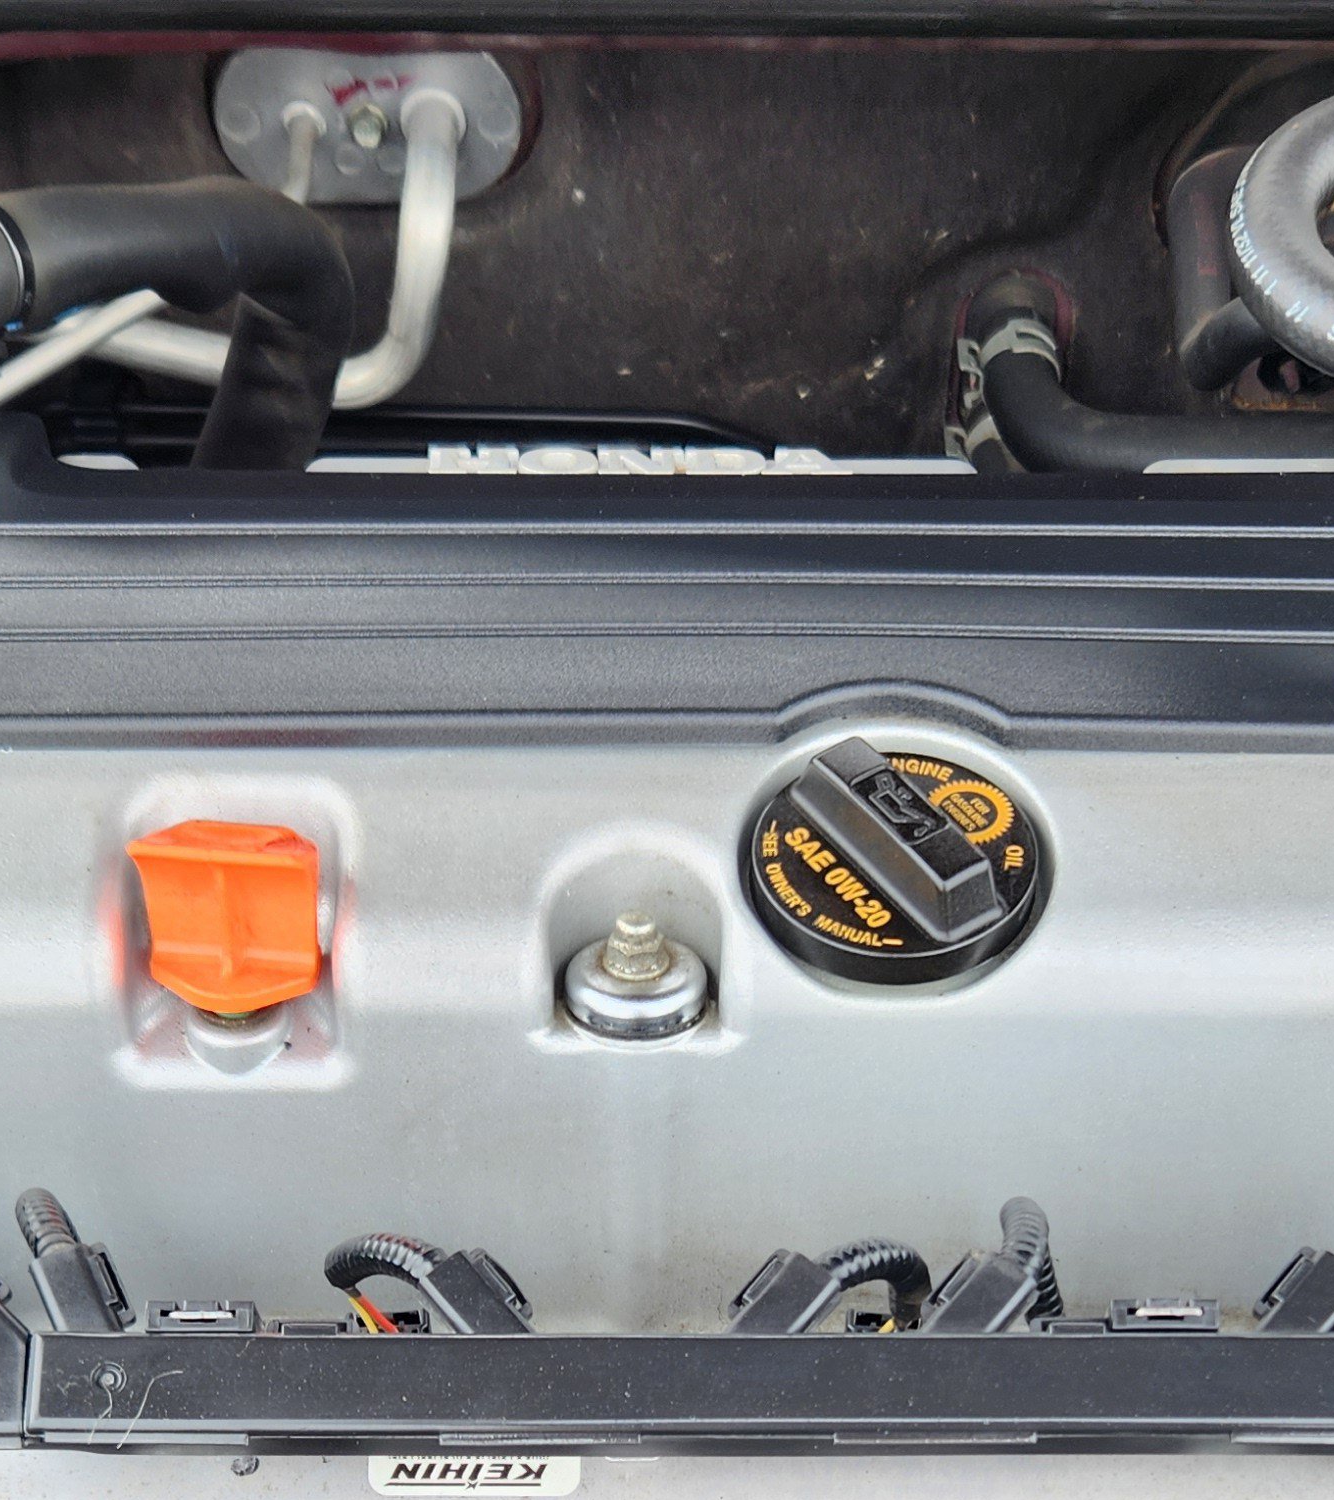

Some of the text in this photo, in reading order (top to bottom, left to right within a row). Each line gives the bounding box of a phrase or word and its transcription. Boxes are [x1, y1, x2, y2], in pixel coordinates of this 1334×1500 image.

[427, 443, 833, 476] HONDA
[886, 756, 1025, 872] NGINE OIL
[949, 793, 989, 828] GASOLINE
[968, 796, 991, 816] FOR
[765, 861, 813, 918] OWNER'S
[784, 826, 892, 929] SAE 0W-20
[389, 1463, 549, 1481] KEIHIN
